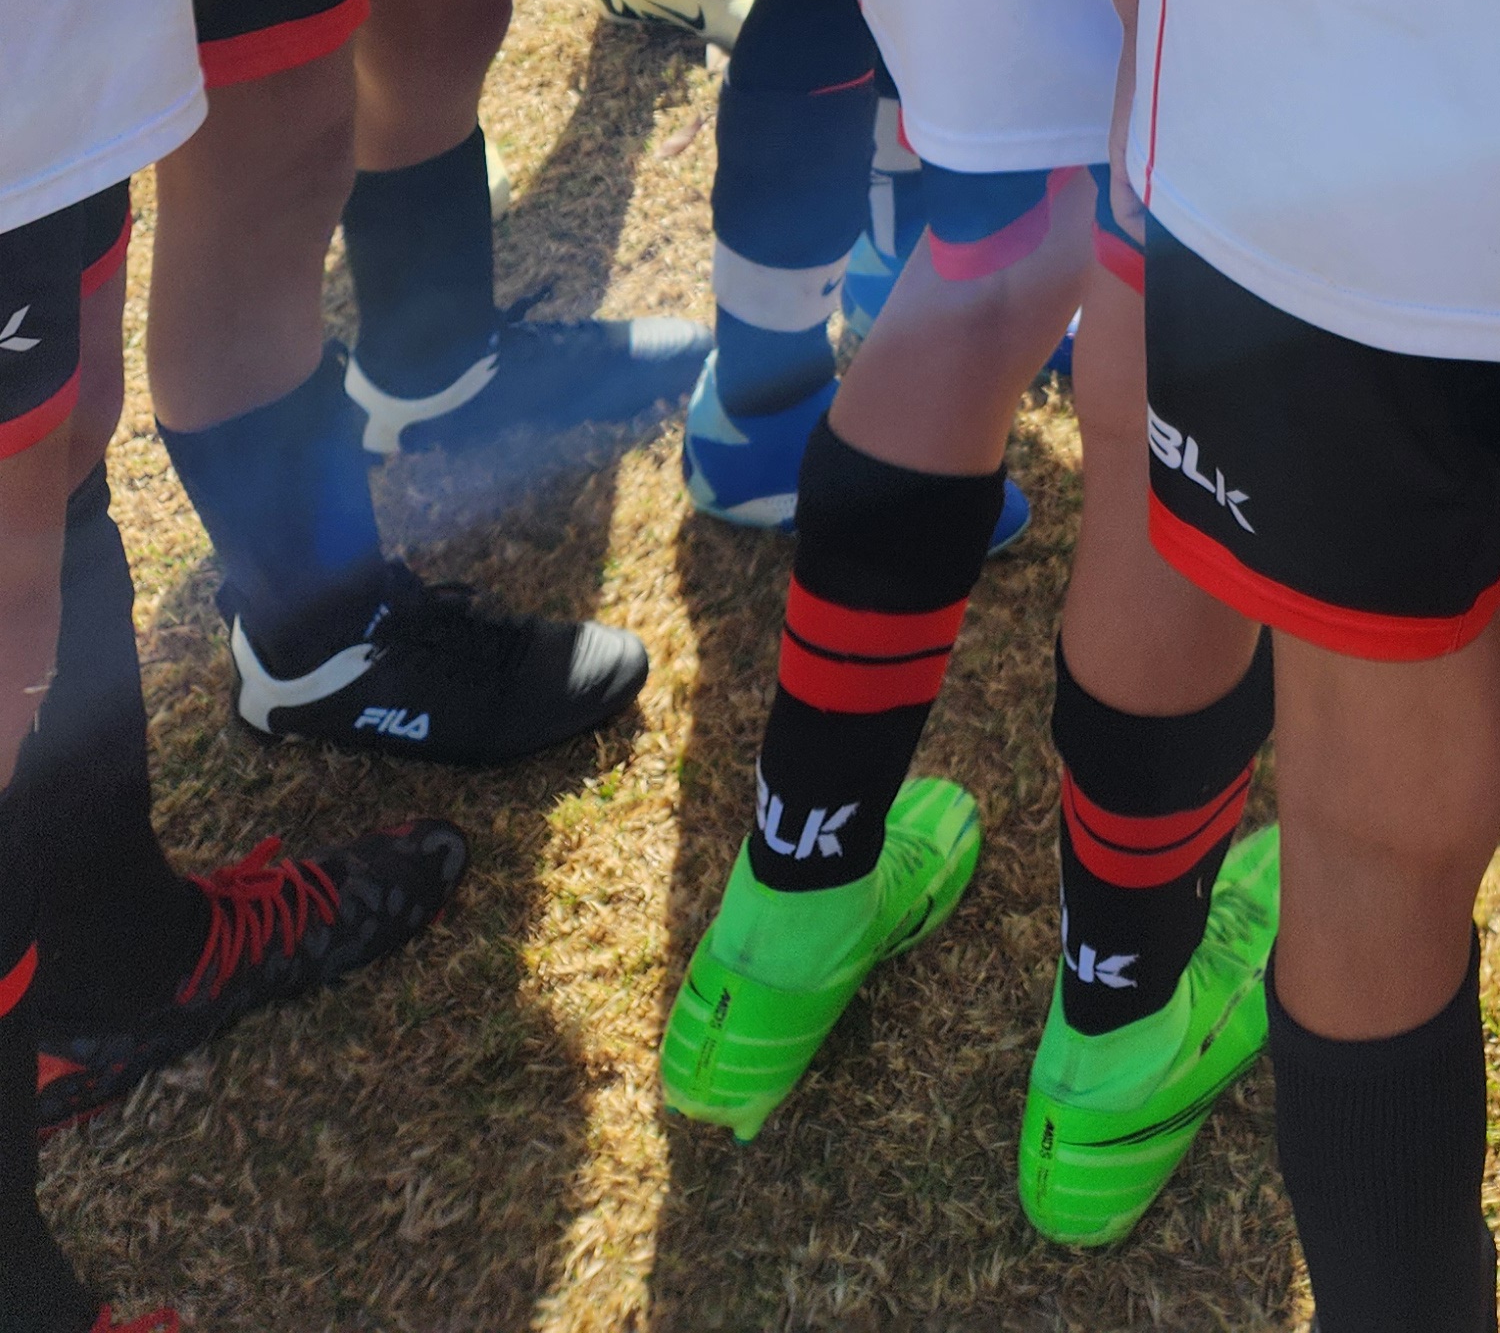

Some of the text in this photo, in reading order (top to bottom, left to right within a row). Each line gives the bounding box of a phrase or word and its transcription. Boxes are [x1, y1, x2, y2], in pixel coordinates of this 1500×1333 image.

[1147, 403, 1256, 534] BLK
[354, 706, 430, 740] FILA
[756, 756, 861, 860] LK
